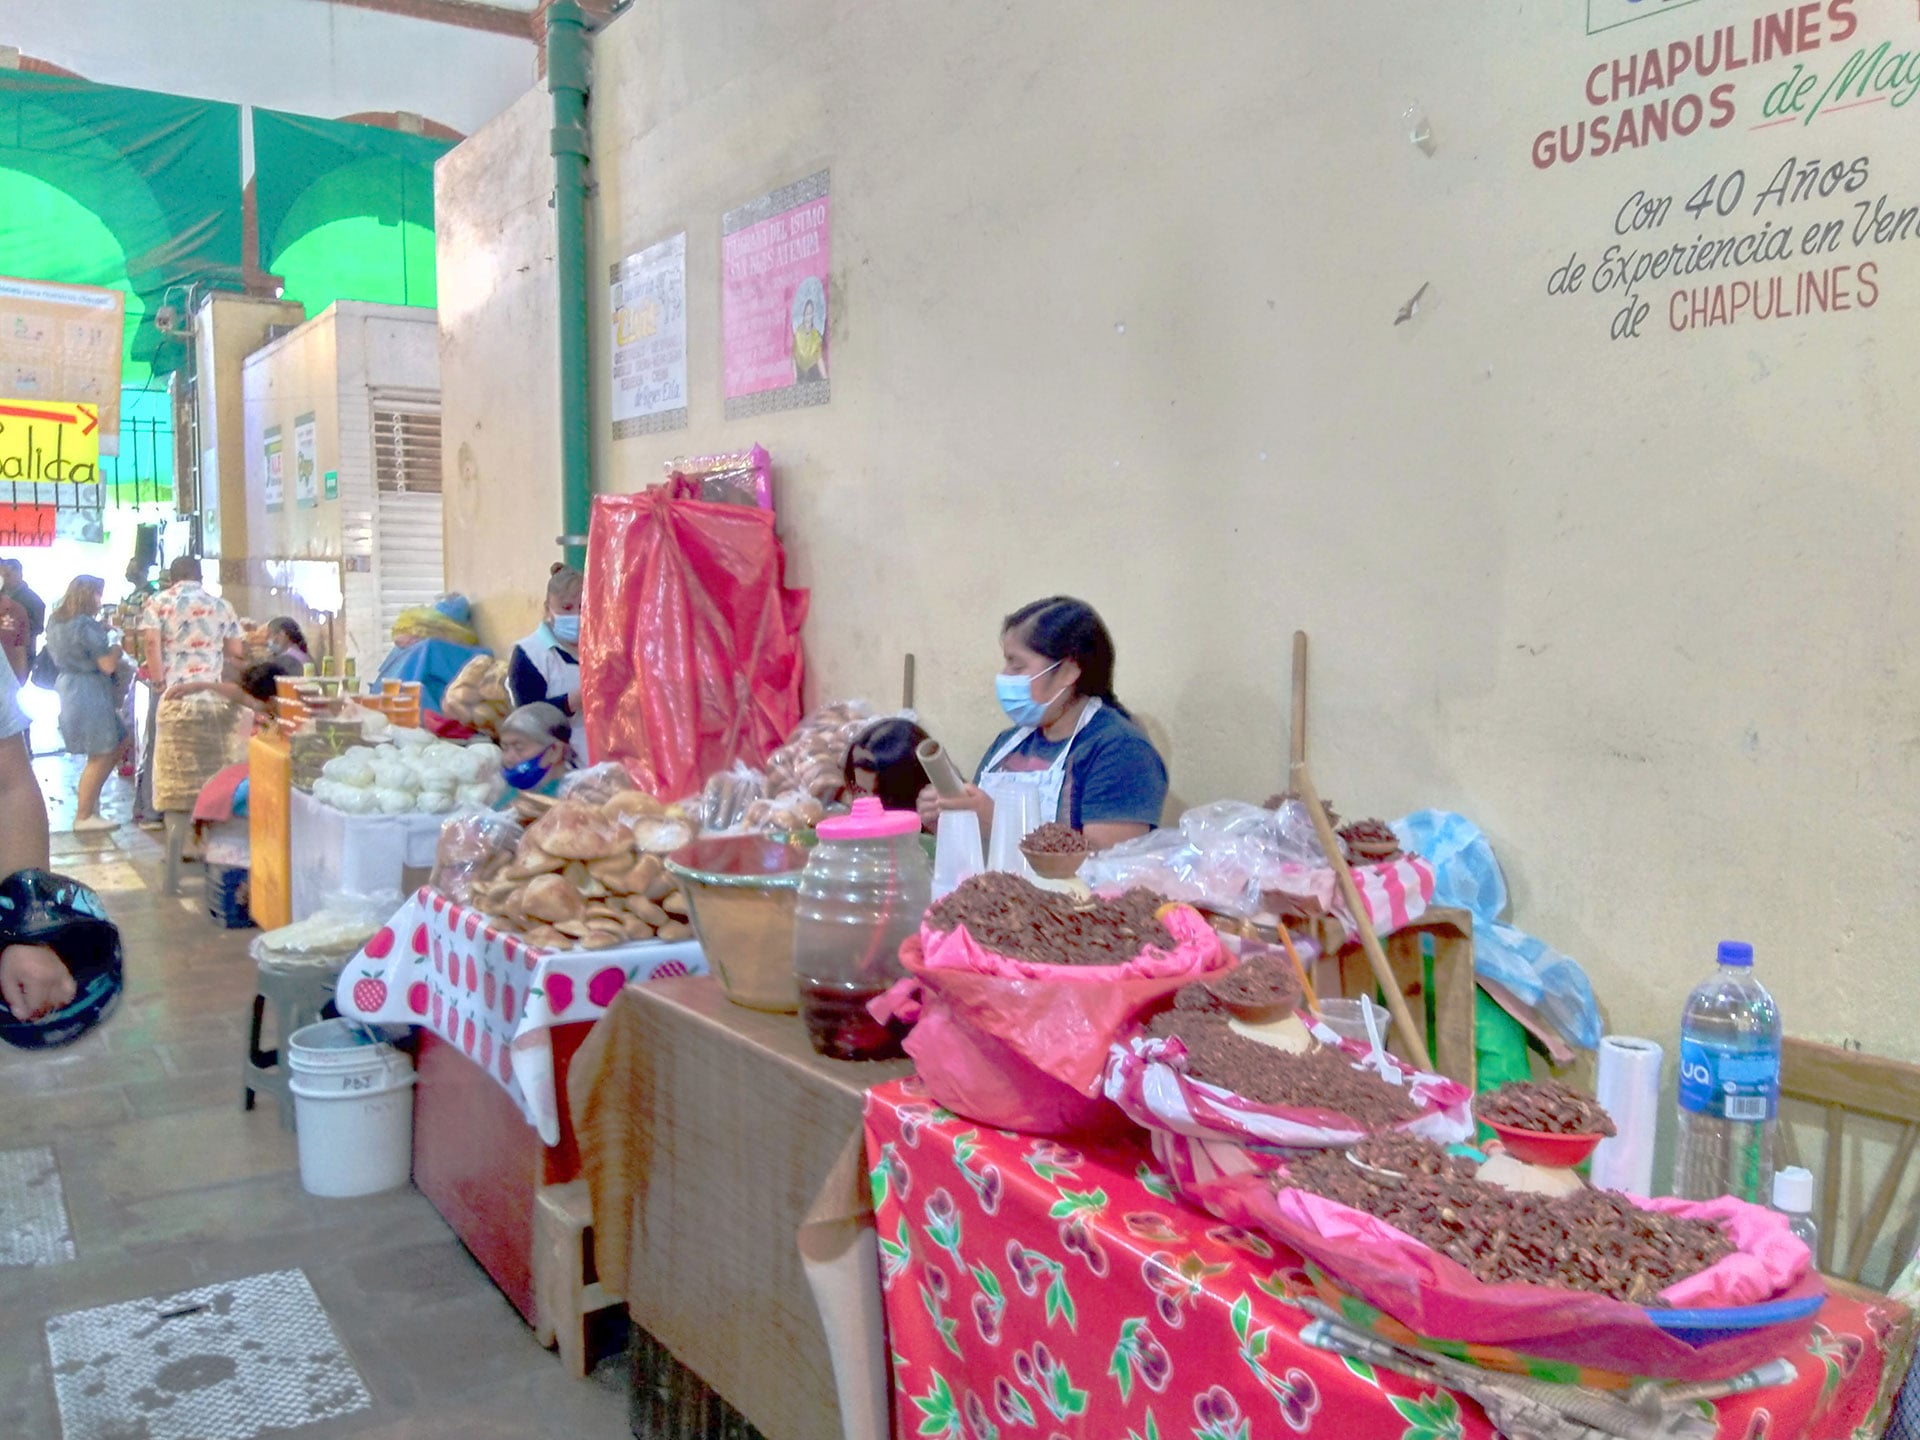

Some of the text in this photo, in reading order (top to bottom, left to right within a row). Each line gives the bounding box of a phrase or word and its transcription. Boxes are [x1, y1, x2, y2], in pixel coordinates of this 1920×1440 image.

[1585, 0, 1858, 106] CHAPULINES
[1532, 83, 1736, 170] GUSANOS
[1762, 64, 1818, 118] de
[1614, 156, 1870, 235] Con 40 Años
[1547, 194, 1920, 297] de Experiencia en Ven
[1611, 261, 1879, 340] de CHAPULINES
[0, 422, 95, 483] alida
